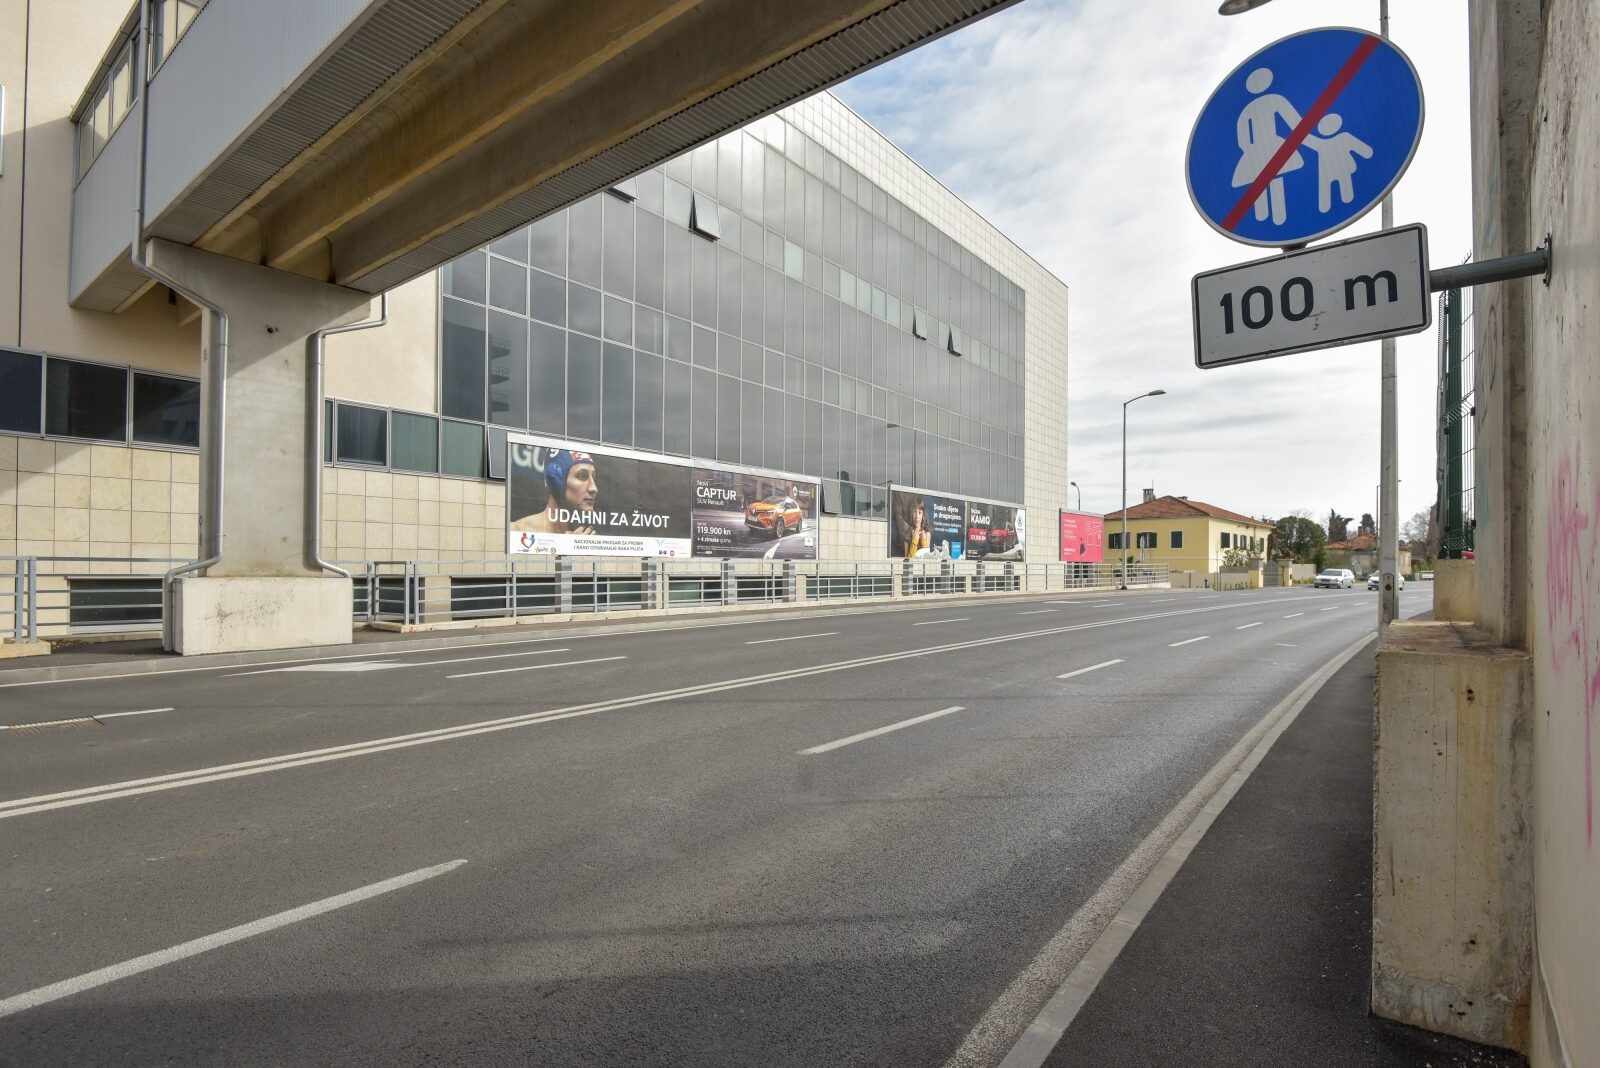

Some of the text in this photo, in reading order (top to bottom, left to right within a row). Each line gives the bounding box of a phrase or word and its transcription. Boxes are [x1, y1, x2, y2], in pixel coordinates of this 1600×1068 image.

[1220, 270, 1398, 334] 100 m
[696, 487, 736, 500] CAPTUR
[548, 508, 669, 528] UDAHNI ZA ŽIVOT
[697, 526, 722, 534] 119.900
